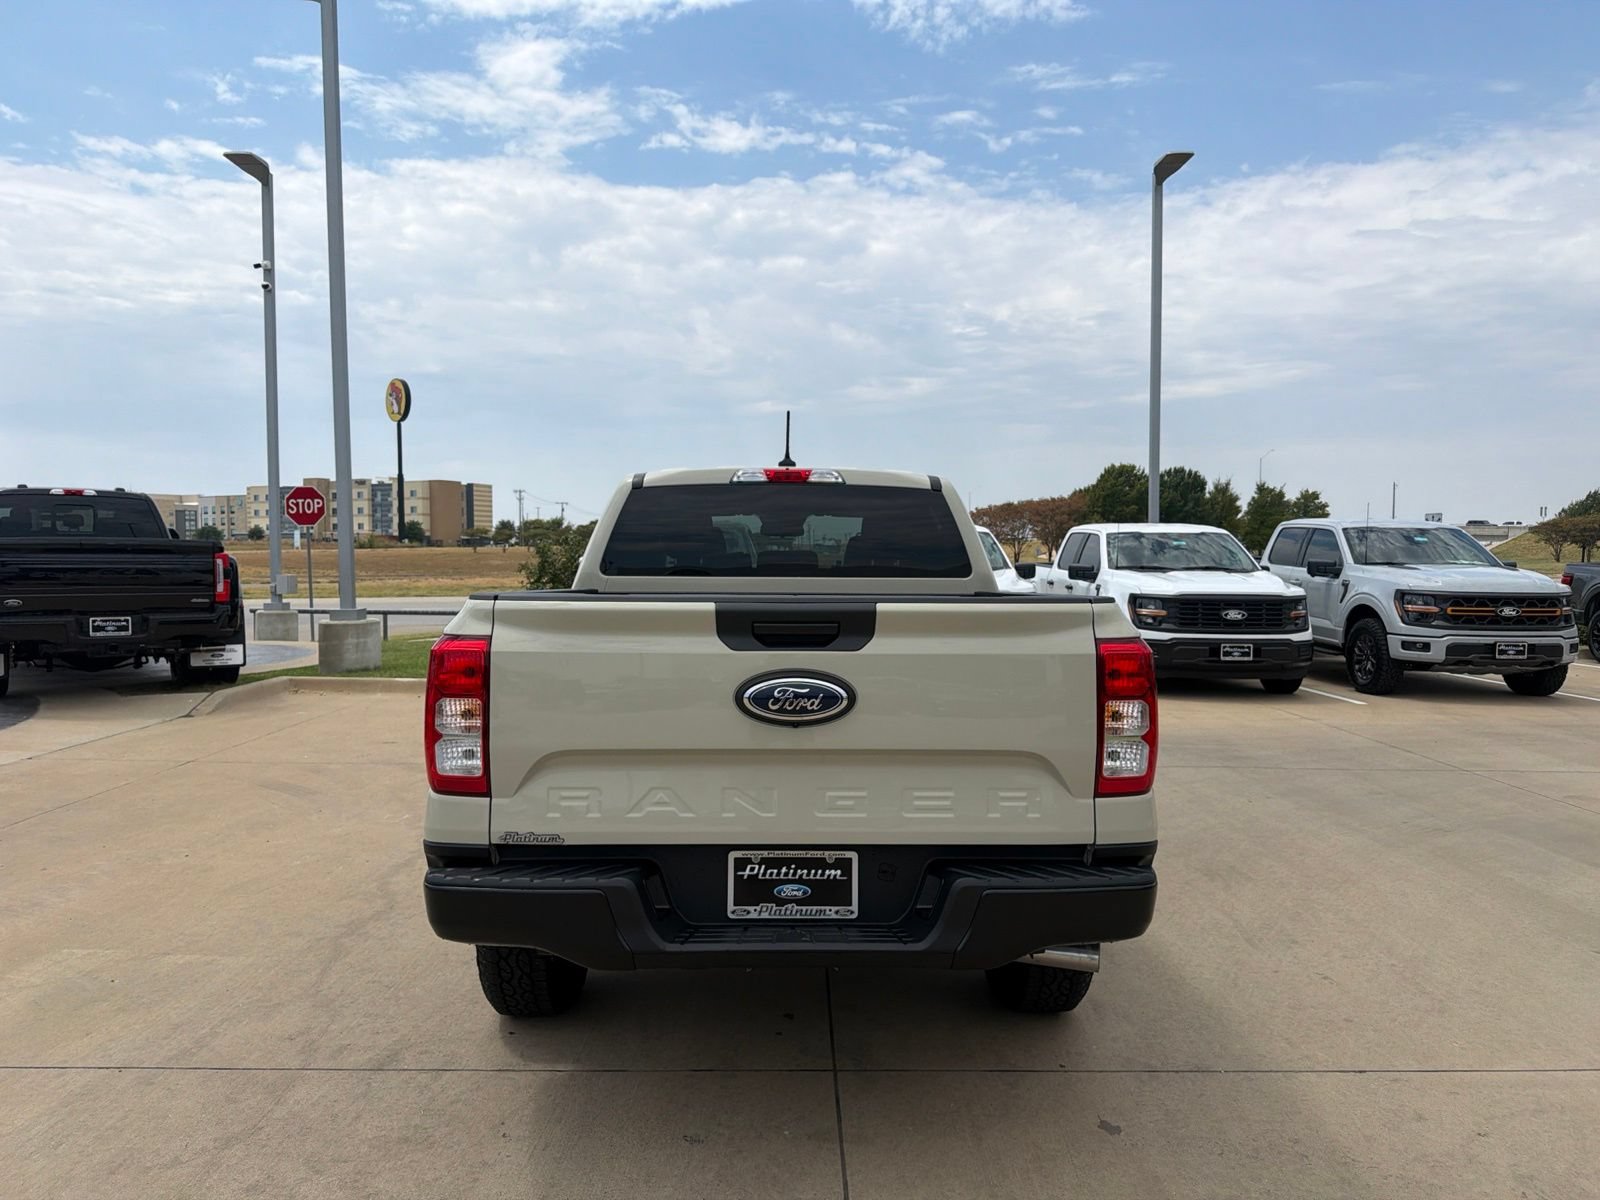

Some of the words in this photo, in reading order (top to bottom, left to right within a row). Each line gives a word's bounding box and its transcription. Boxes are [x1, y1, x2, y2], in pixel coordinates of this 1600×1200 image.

[288, 498, 323, 514] STOP
[768, 686, 824, 711] Ford
[545, 786, 1041, 819] RANGER
[499, 831, 564, 844] Platinum
[736, 864, 848, 880] Platinum
[780, 887, 804, 897] Ford
[757, 903, 833, 917] Platinum
